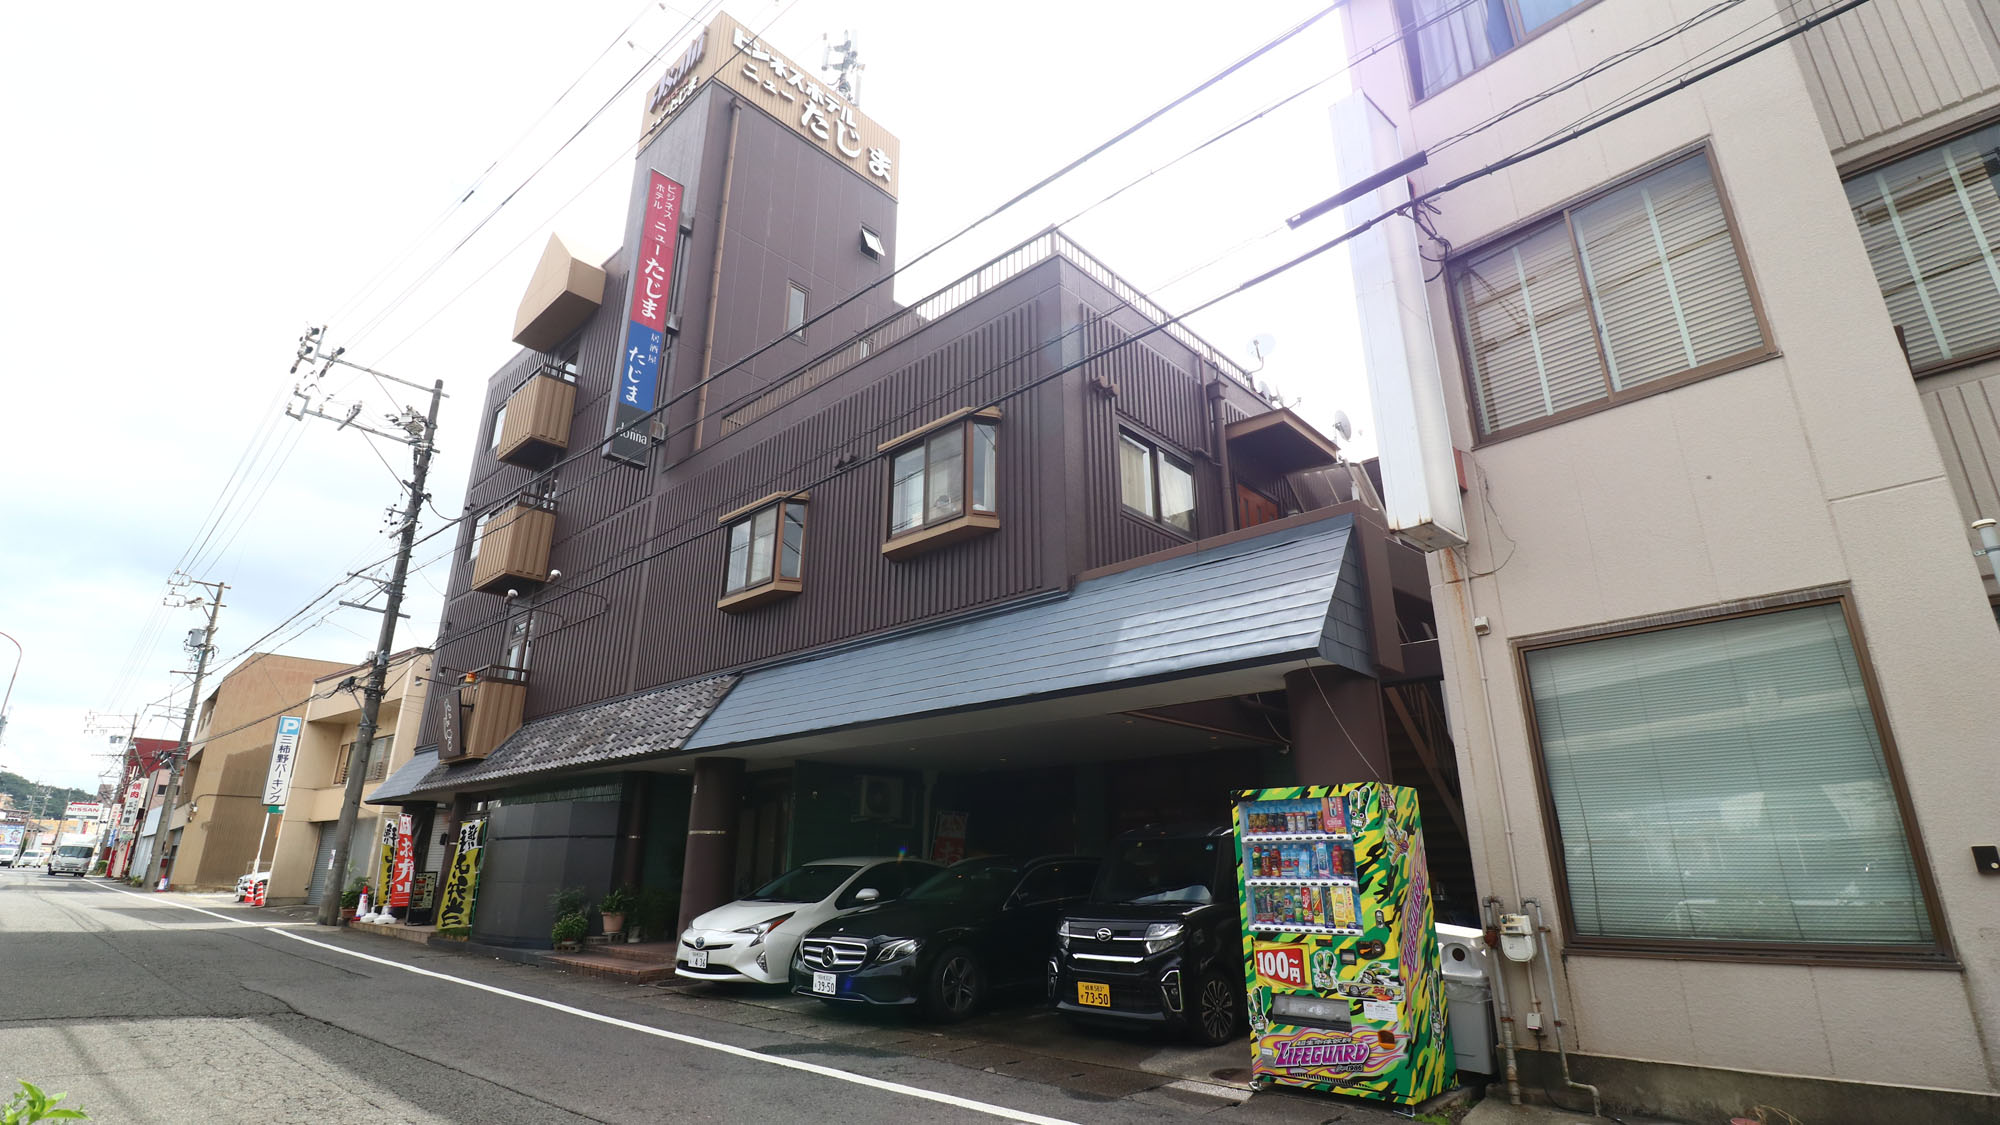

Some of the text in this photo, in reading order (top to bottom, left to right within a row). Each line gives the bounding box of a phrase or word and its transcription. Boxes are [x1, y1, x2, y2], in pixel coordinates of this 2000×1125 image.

[732, 27, 857, 131] ビジネスホテル
[653, 183, 665, 210] ホテル
[664, 184, 678, 221] ビジネス
[641, 220, 667, 320] ニューたじま
[625, 346, 647, 405] たじま
[616, 422, 648, 446] donna
[281, 719, 299, 733] P
[392, 837, 415, 905] お弁当
[1085, 992, 1108, 1005] 73-50
[1275, 1041, 1370, 1067] LIFEGUARD
